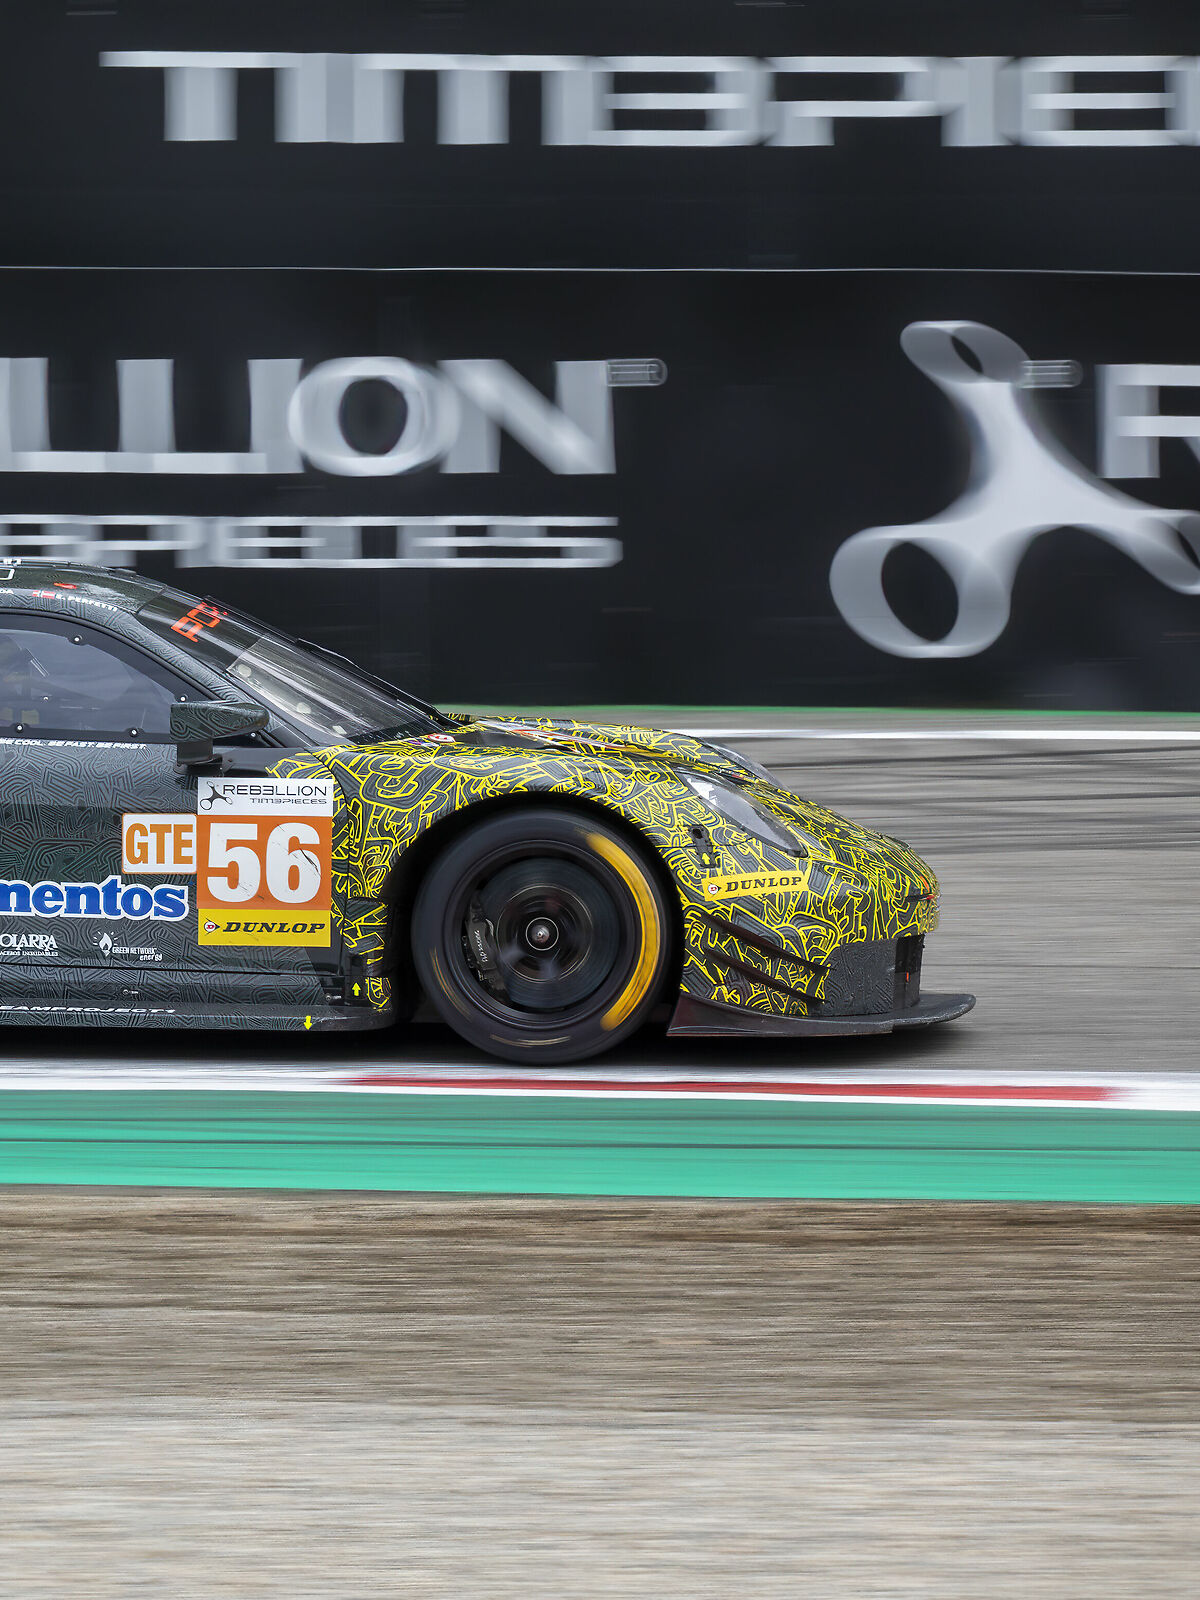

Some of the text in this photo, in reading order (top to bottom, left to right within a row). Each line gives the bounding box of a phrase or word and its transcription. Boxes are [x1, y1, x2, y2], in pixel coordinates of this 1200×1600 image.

[223, 784, 327, 796] REBELLION
[125, 823, 194, 865] GTE
[207, 822, 322, 904] 56
[725, 876, 802, 893] DUNLOP
[222, 921, 326, 934] DUNLOP
